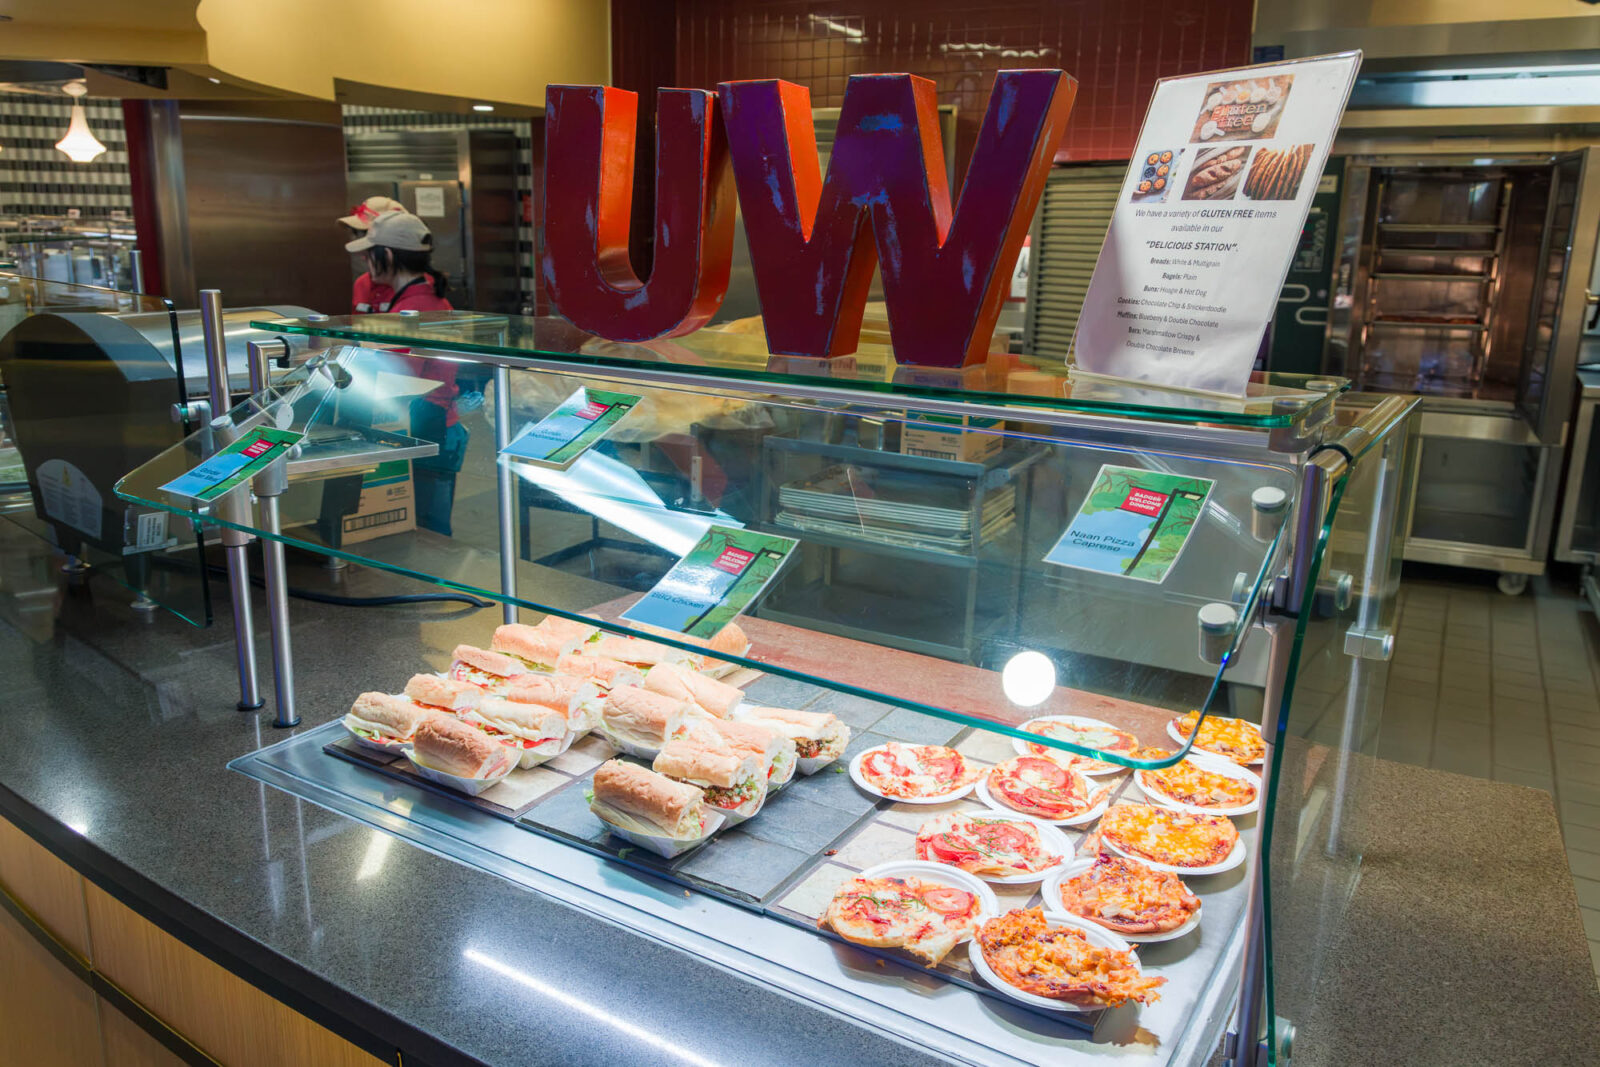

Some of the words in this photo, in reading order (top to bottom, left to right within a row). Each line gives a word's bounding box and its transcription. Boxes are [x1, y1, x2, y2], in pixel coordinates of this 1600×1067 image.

[543, 68, 1078, 368] UW
[1135, 209, 1145, 217] We
[1147, 209, 1162, 217] have
[1169, 210, 1190, 219] variety
[1191, 209, 1200, 217] of
[1200, 209, 1231, 218] GLUTEN
[1232, 209, 1254, 218] FREE
[1254, 210, 1277, 218] items
[1171, 224, 1201, 232] available
[1201, 224, 1209, 232] in
[1150, 257, 1170, 265] Breads:
[1162, 272, 1182, 280] Bagels:
[1195, 289, 1207, 297] Dog
[1168, 316, 1188, 324] Double
[1189, 318, 1219, 328] Chocolate
[1129, 496, 1162, 508] WELCOME
[1134, 492, 1162, 502] BADGER
[1070, 530, 1101, 542] Naan
[1103, 535, 1135, 547] Pizza
[1072, 538, 1121, 552] Caprese
